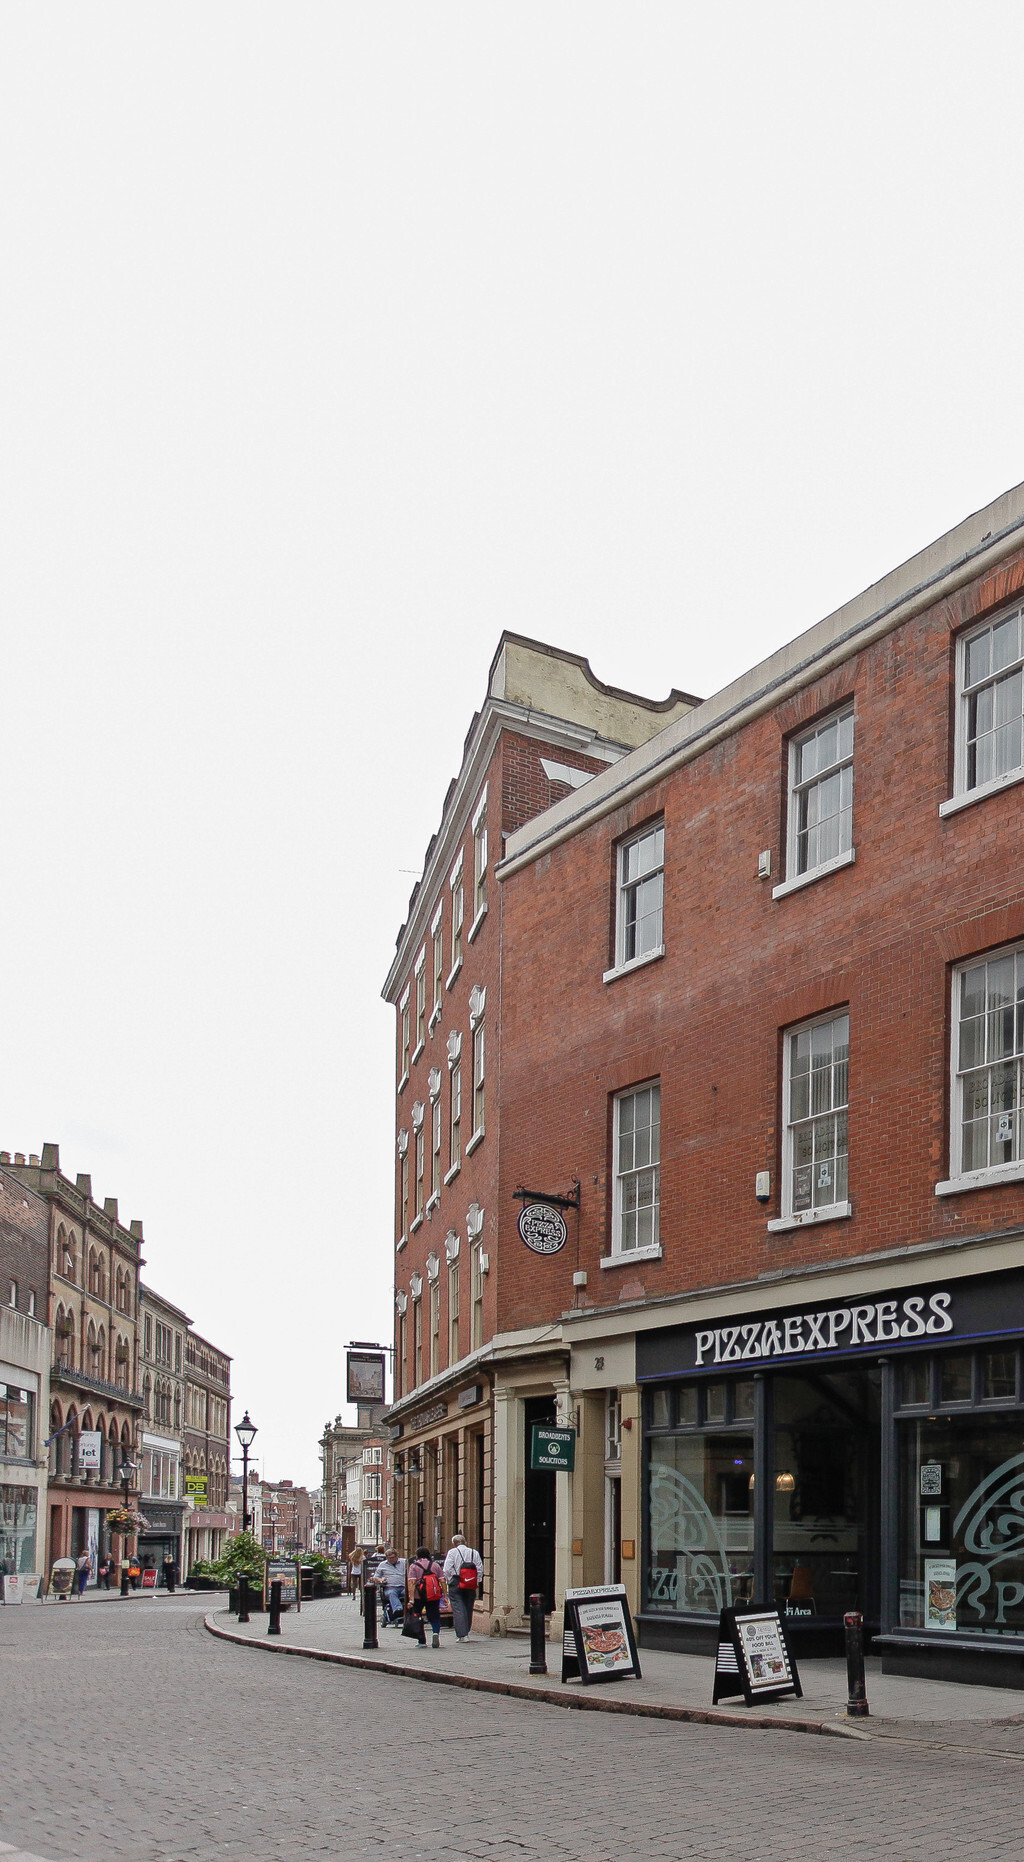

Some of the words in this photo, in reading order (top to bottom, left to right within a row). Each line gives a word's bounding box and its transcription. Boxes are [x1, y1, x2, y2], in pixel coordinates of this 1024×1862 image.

[531, 1219, 555, 1230] PIZZA
[525, 1224, 561, 1237] EXPRESS
[694, 1292, 954, 1366] PIZZAEXPRESS
[538, 1431, 571, 1441] BROADBENTS
[82, 1448, 96, 1457] let
[538, 1456, 568, 1465] SOLICITORS
[794, 1606, 811, 1616] Area
